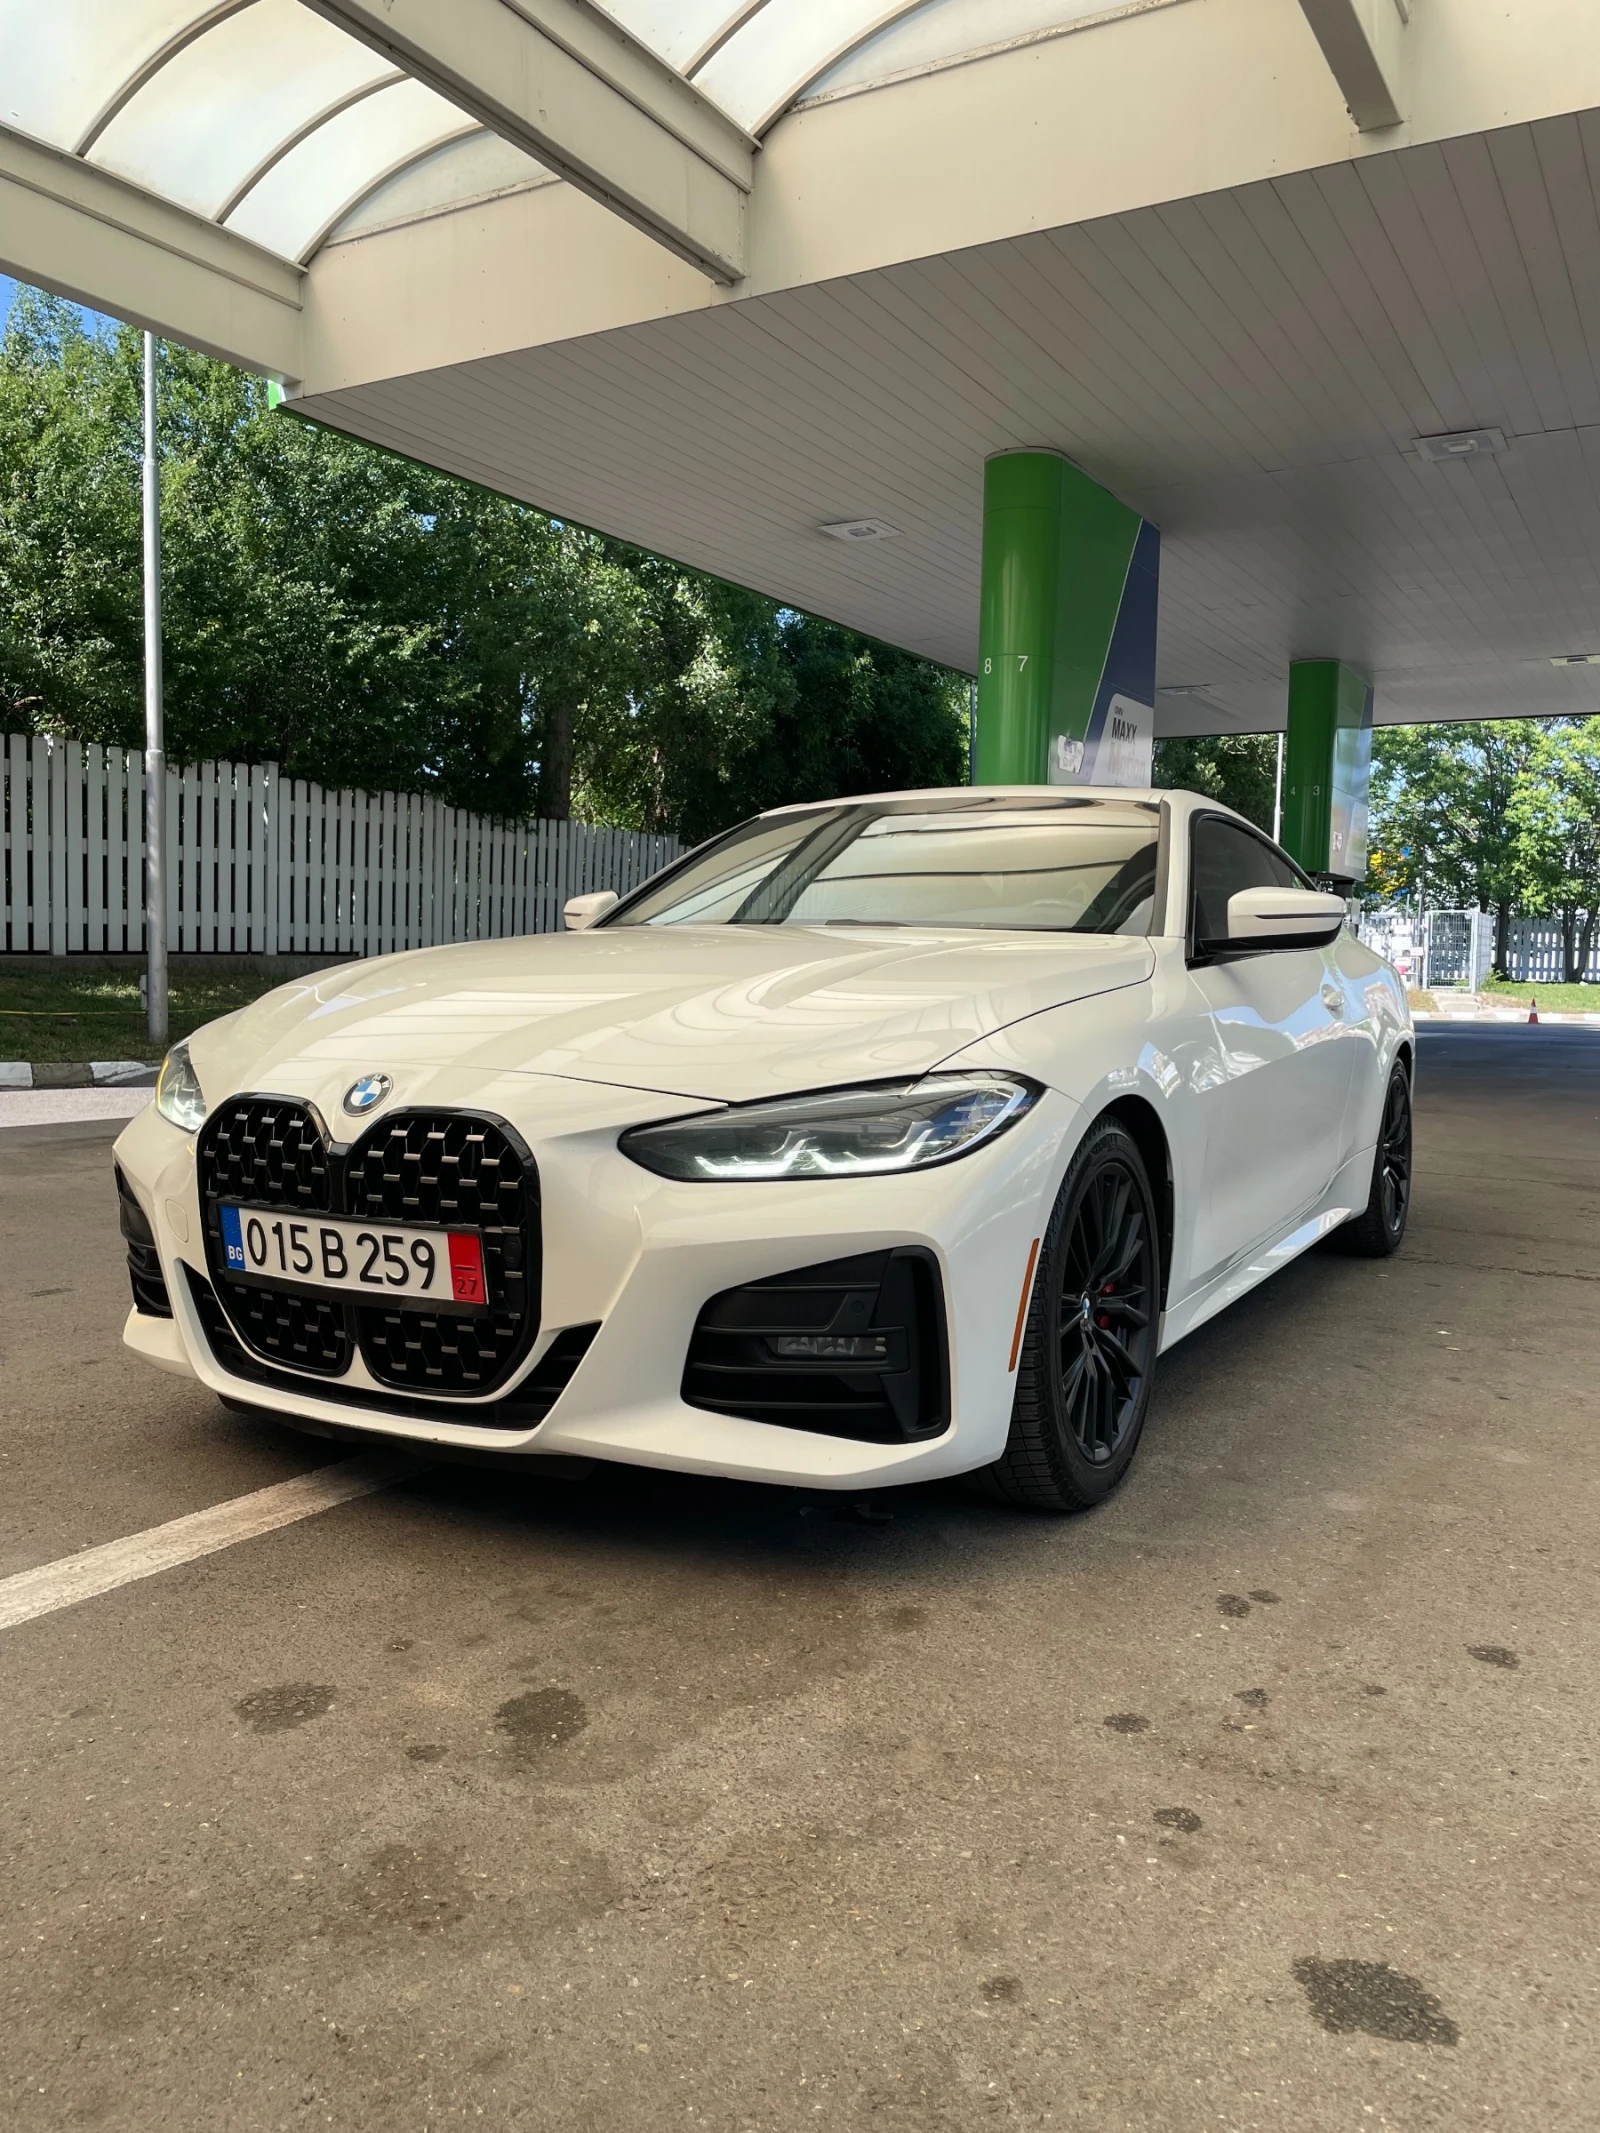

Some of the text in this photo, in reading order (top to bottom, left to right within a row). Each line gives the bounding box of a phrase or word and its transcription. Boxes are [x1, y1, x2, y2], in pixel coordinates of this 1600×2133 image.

[985, 656, 1028, 674] 8 7
[1112, 717, 1138, 744] MAXX
[1290, 785, 1320, 796] 4 3
[228, 1245, 244, 1261] BG
[456, 1278, 478, 1296] 27
